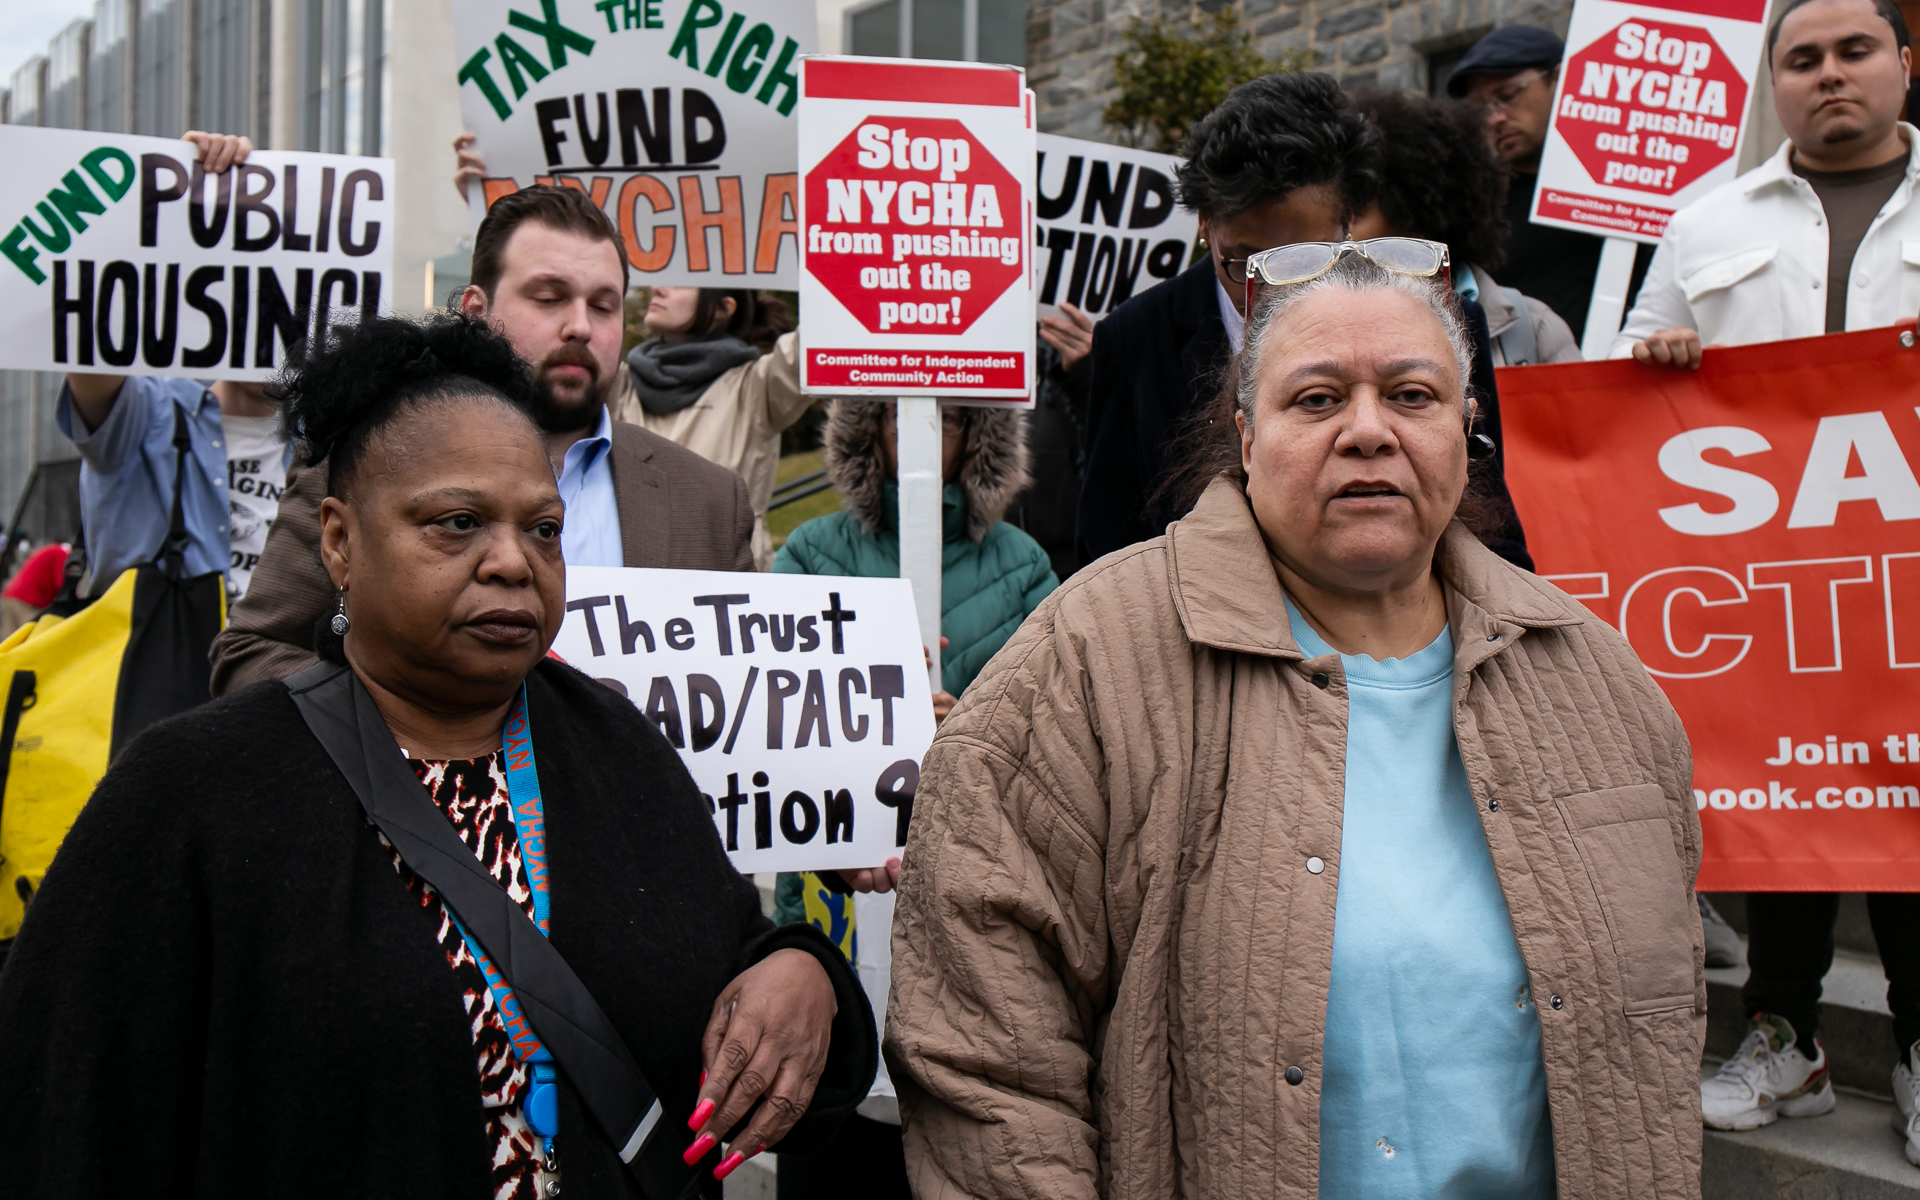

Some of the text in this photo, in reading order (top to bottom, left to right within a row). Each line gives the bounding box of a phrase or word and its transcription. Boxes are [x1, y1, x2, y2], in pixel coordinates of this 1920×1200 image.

[458, 0, 798, 122] TAX THE RICH
[1614, 22, 1712, 76] Stop
[1579, 60, 1728, 118] NYCHA
[535, 87, 726, 166] FUND
[1560, 94, 1737, 150] from pushing
[1595, 132, 1689, 163] out the
[857, 124, 970, 182] Stop
[1603, 160, 1677, 189] poor!
[0, 146, 384, 285] FUND PUBLIC
[481, 172, 798, 274] CHA
[826, 178, 1003, 227] NYCHA
[1547, 191, 1614, 213] Committee
[1615, 203, 1633, 216] for
[1570, 208, 1640, 231] Community
[808, 224, 1019, 266] from pushing
[1037, 223, 1148, 314] TION
[860, 263, 971, 291] out the
[879, 296, 961, 330] poor!
[816, 353, 1016, 369] Committee for Independent
[849, 370, 984, 385] Community Action
[1658, 407, 1920, 536] SA
[567, 592, 856, 657] The Trust
[597, 665, 904, 754] AD/PACT
[1765, 735, 1870, 766] Join
[702, 771, 855, 851] tion
[517, 797, 550, 891] NYCHA
